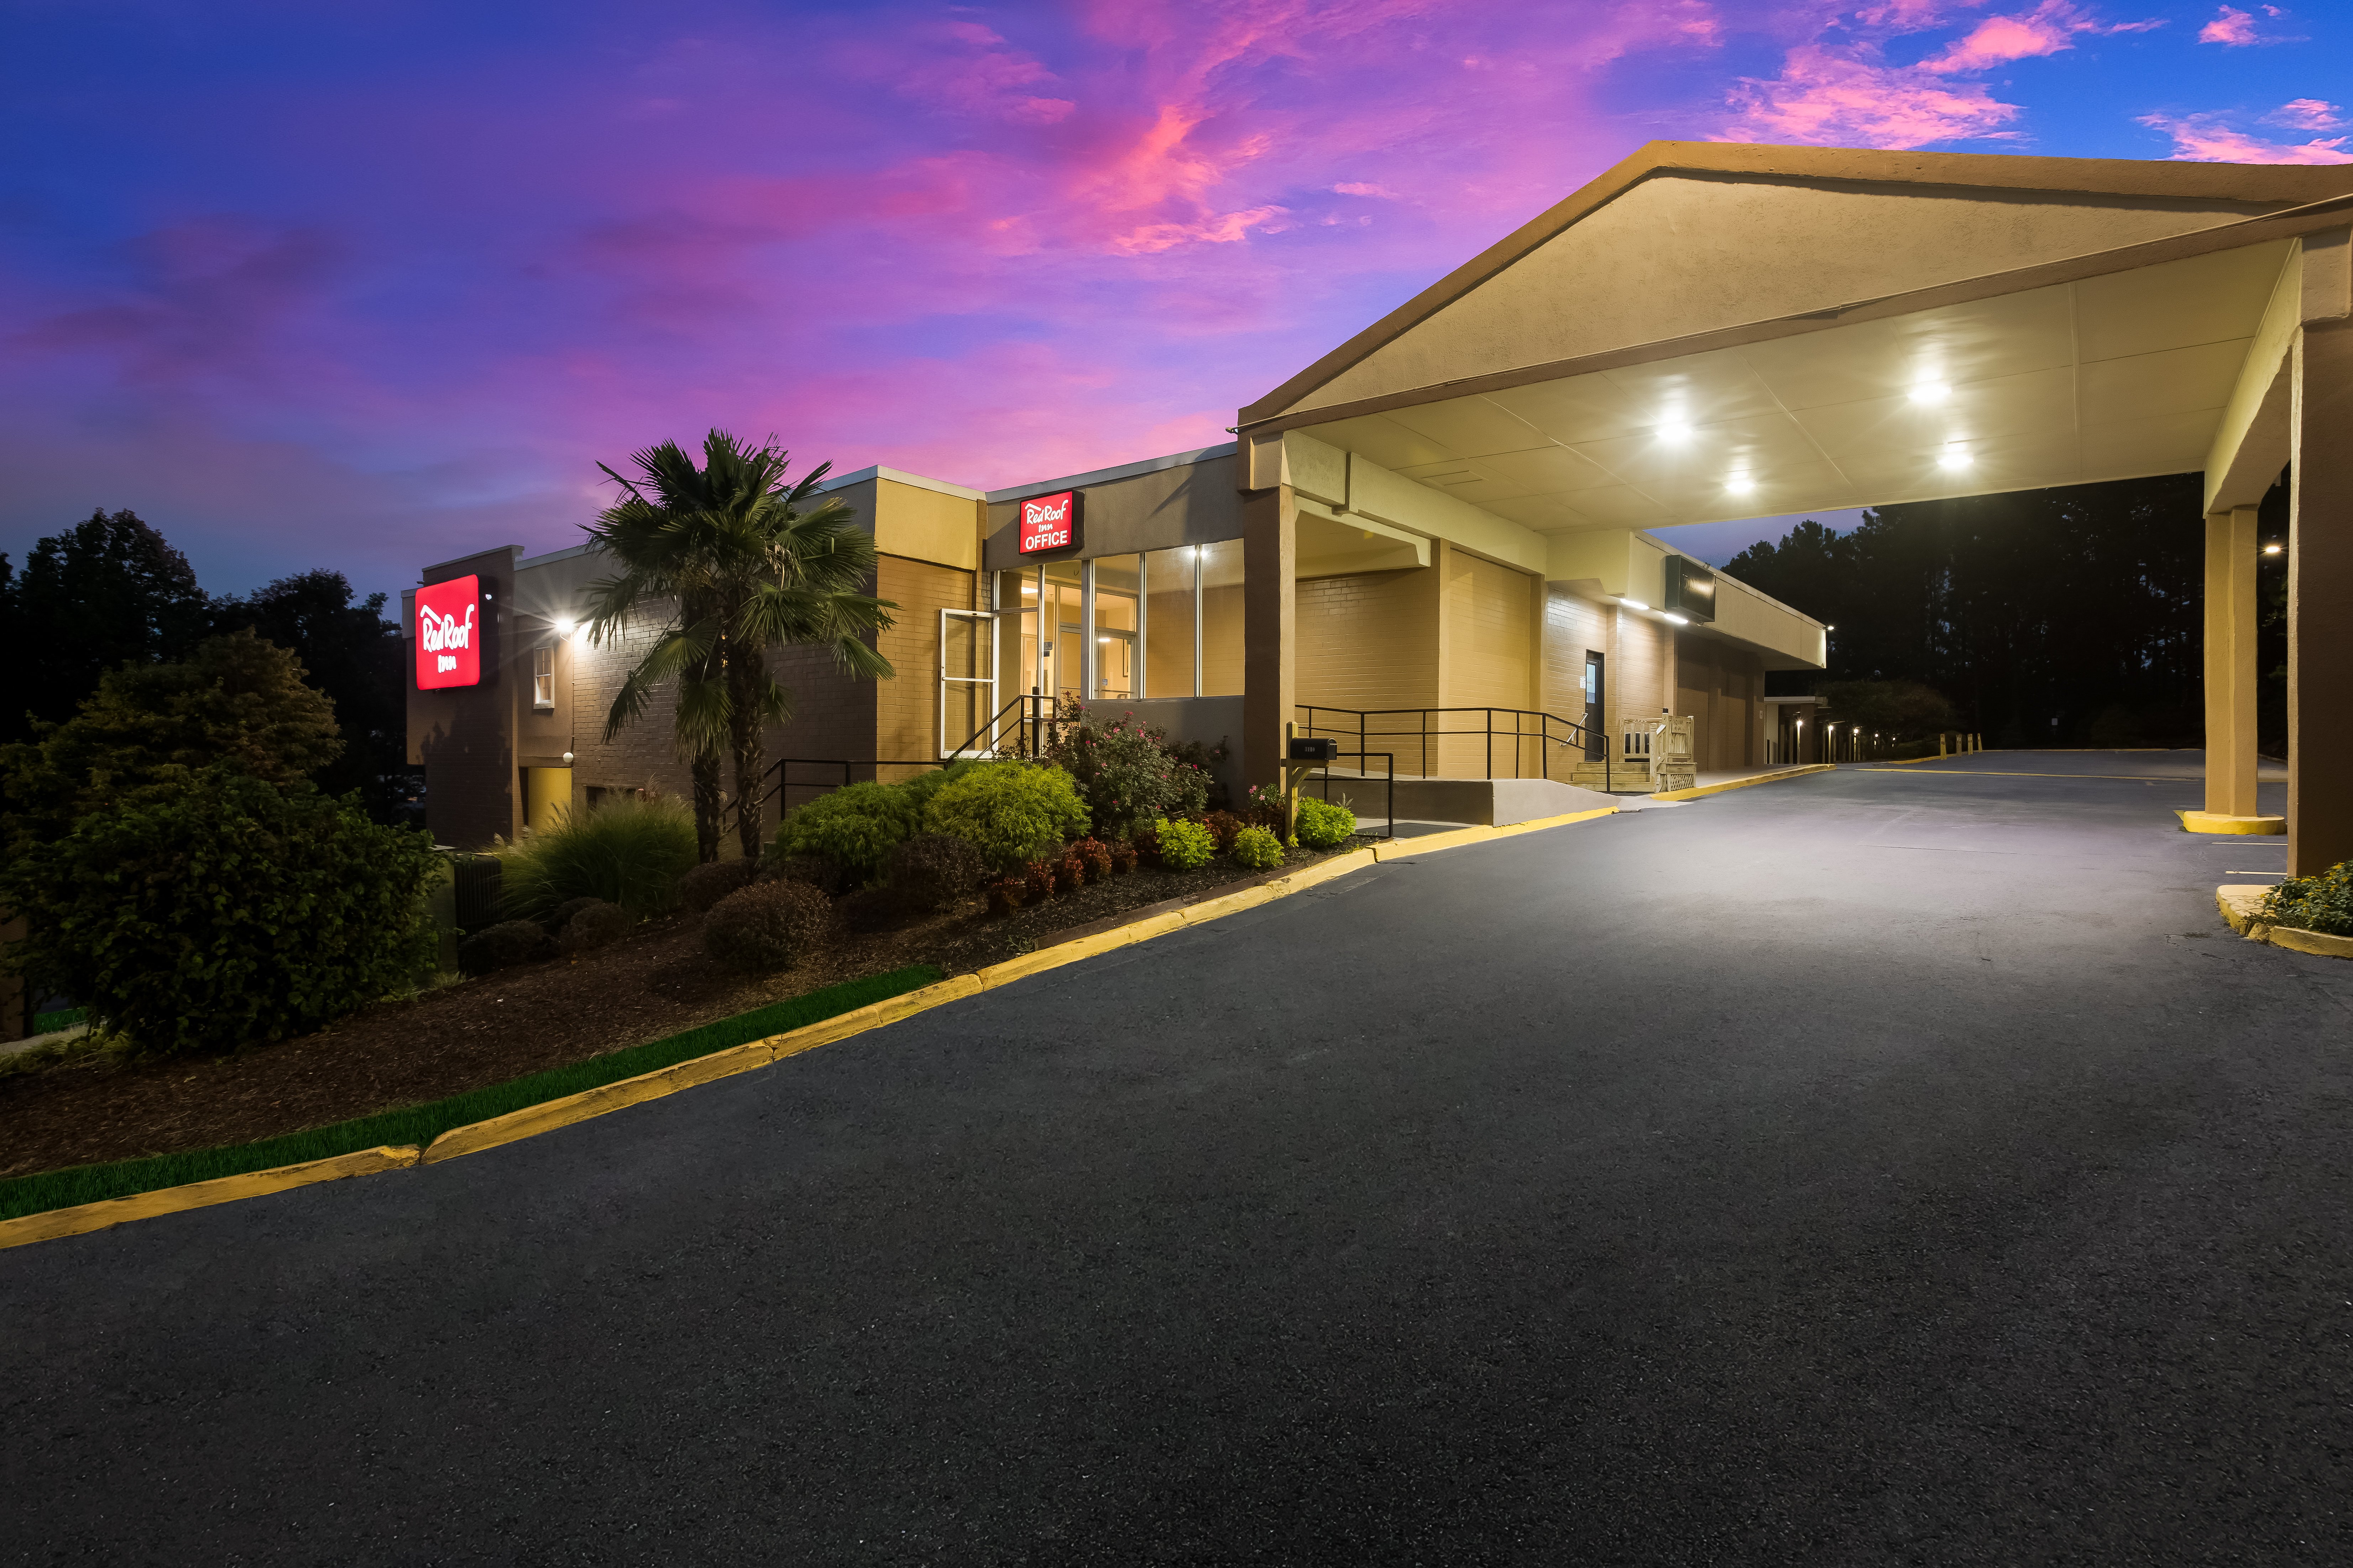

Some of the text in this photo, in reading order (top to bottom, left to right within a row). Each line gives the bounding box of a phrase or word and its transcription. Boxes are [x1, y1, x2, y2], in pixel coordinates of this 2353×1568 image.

[1039, 523, 1053, 533] Inn
[1025, 530, 1067, 550] OFFICE
[438, 655, 456, 673] Inn
